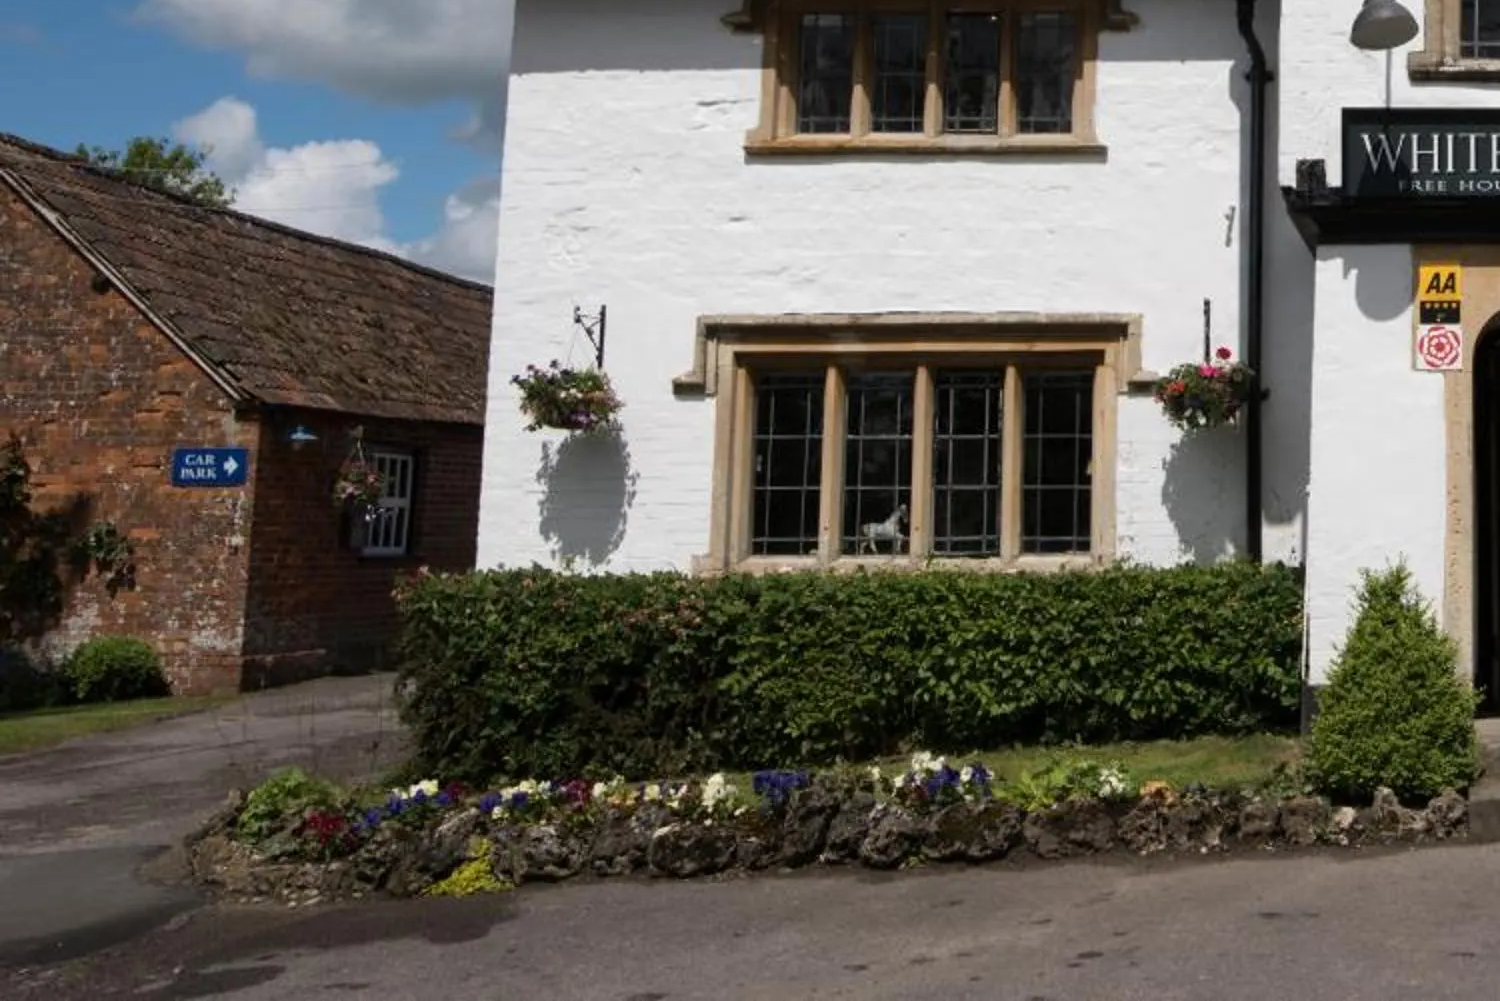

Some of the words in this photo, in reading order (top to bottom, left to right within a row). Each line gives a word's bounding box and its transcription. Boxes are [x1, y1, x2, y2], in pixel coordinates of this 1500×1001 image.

[1398, 180, 1448, 192] FREE
[1426, 271, 1457, 294] AA
[185, 454, 216, 466] CAR
[181, 466, 217, 480] PARK
